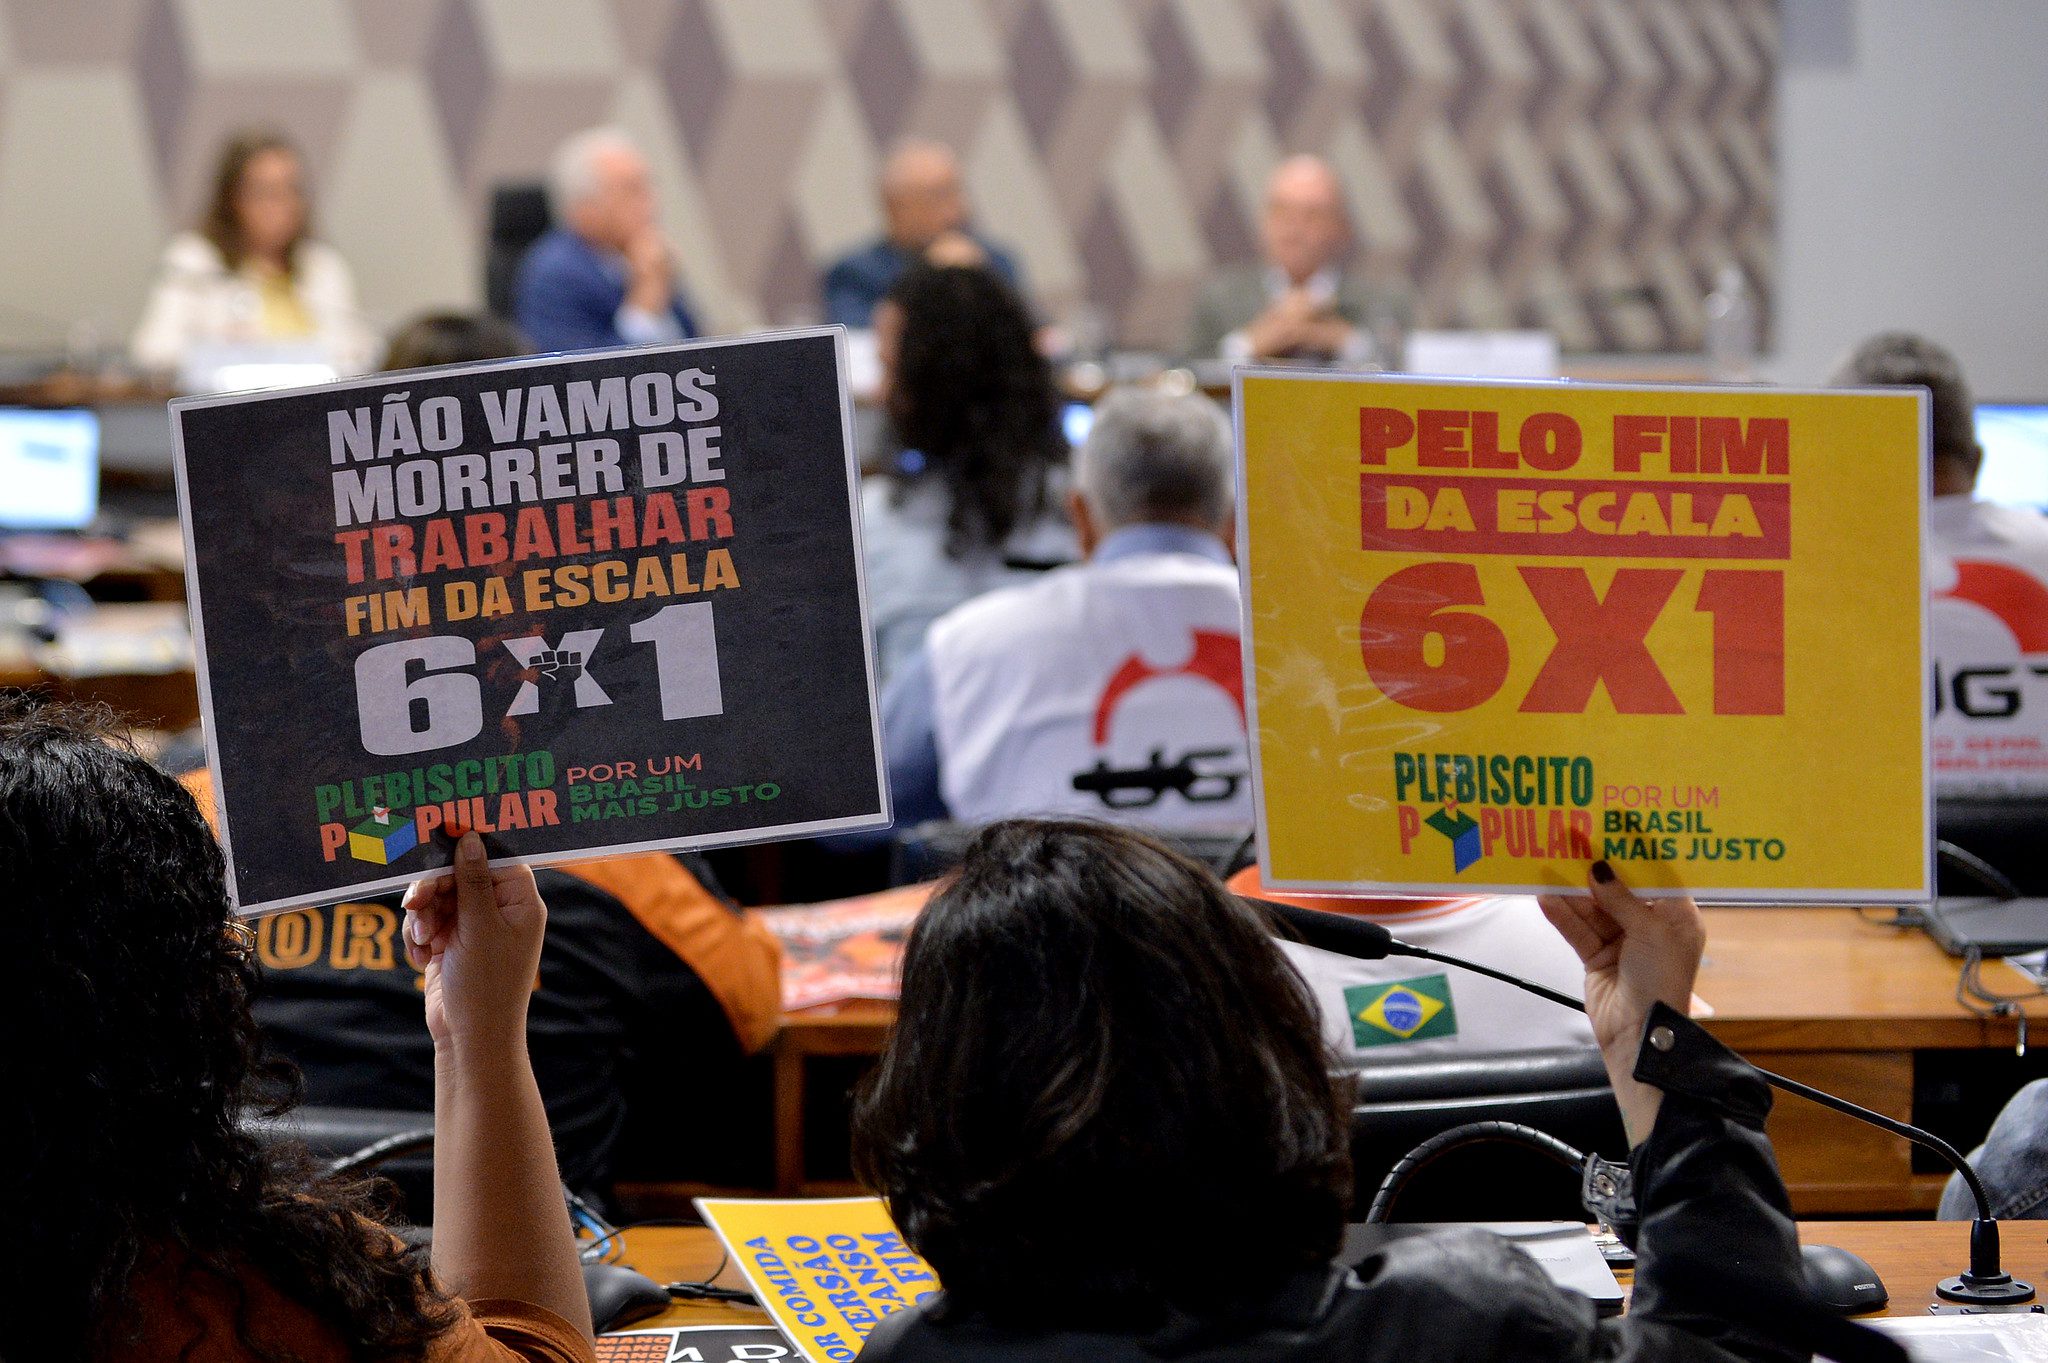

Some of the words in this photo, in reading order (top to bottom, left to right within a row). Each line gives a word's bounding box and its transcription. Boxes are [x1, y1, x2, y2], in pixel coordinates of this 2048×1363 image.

[327, 391, 464, 465] NÃO
[480, 368, 720, 444] VAMOS
[1359, 406, 1584, 471] PELO
[1613, 415, 1790, 475] FIM
[332, 438, 625, 527] MORRER
[639, 426, 726, 488] DE
[334, 486, 735, 585] TRABALHAR
[1385, 486, 1477, 532] DA
[1497, 489, 1765, 538] ESCALA
[345, 587, 430, 636] FIM
[445, 576, 514, 621] DA
[523, 548, 741, 612] ESCALA
[1359, 561, 1786, 716] 6X1
[314, 751, 555, 823] PLEBISCITO
[566, 761, 637, 785] POR
[647, 753, 702, 776] UM
[569, 773, 696, 803] BRASIL
[1394, 752, 1594, 806] PLEBISCITO
[1602, 785, 1663, 808] POR
[1672, 786, 1720, 809] UM
[319, 789, 561, 863] PPULAR
[571, 794, 663, 823] MAIS
[667, 783, 781, 812] JUSTO
[1397, 806, 1594, 860] PPULAR
[1603, 810, 1713, 833] BRASIL
[1603, 837, 1677, 861] MAIS
[1686, 838, 1786, 862] JUSTO
[745, 1236, 827, 1327] COMIDA
